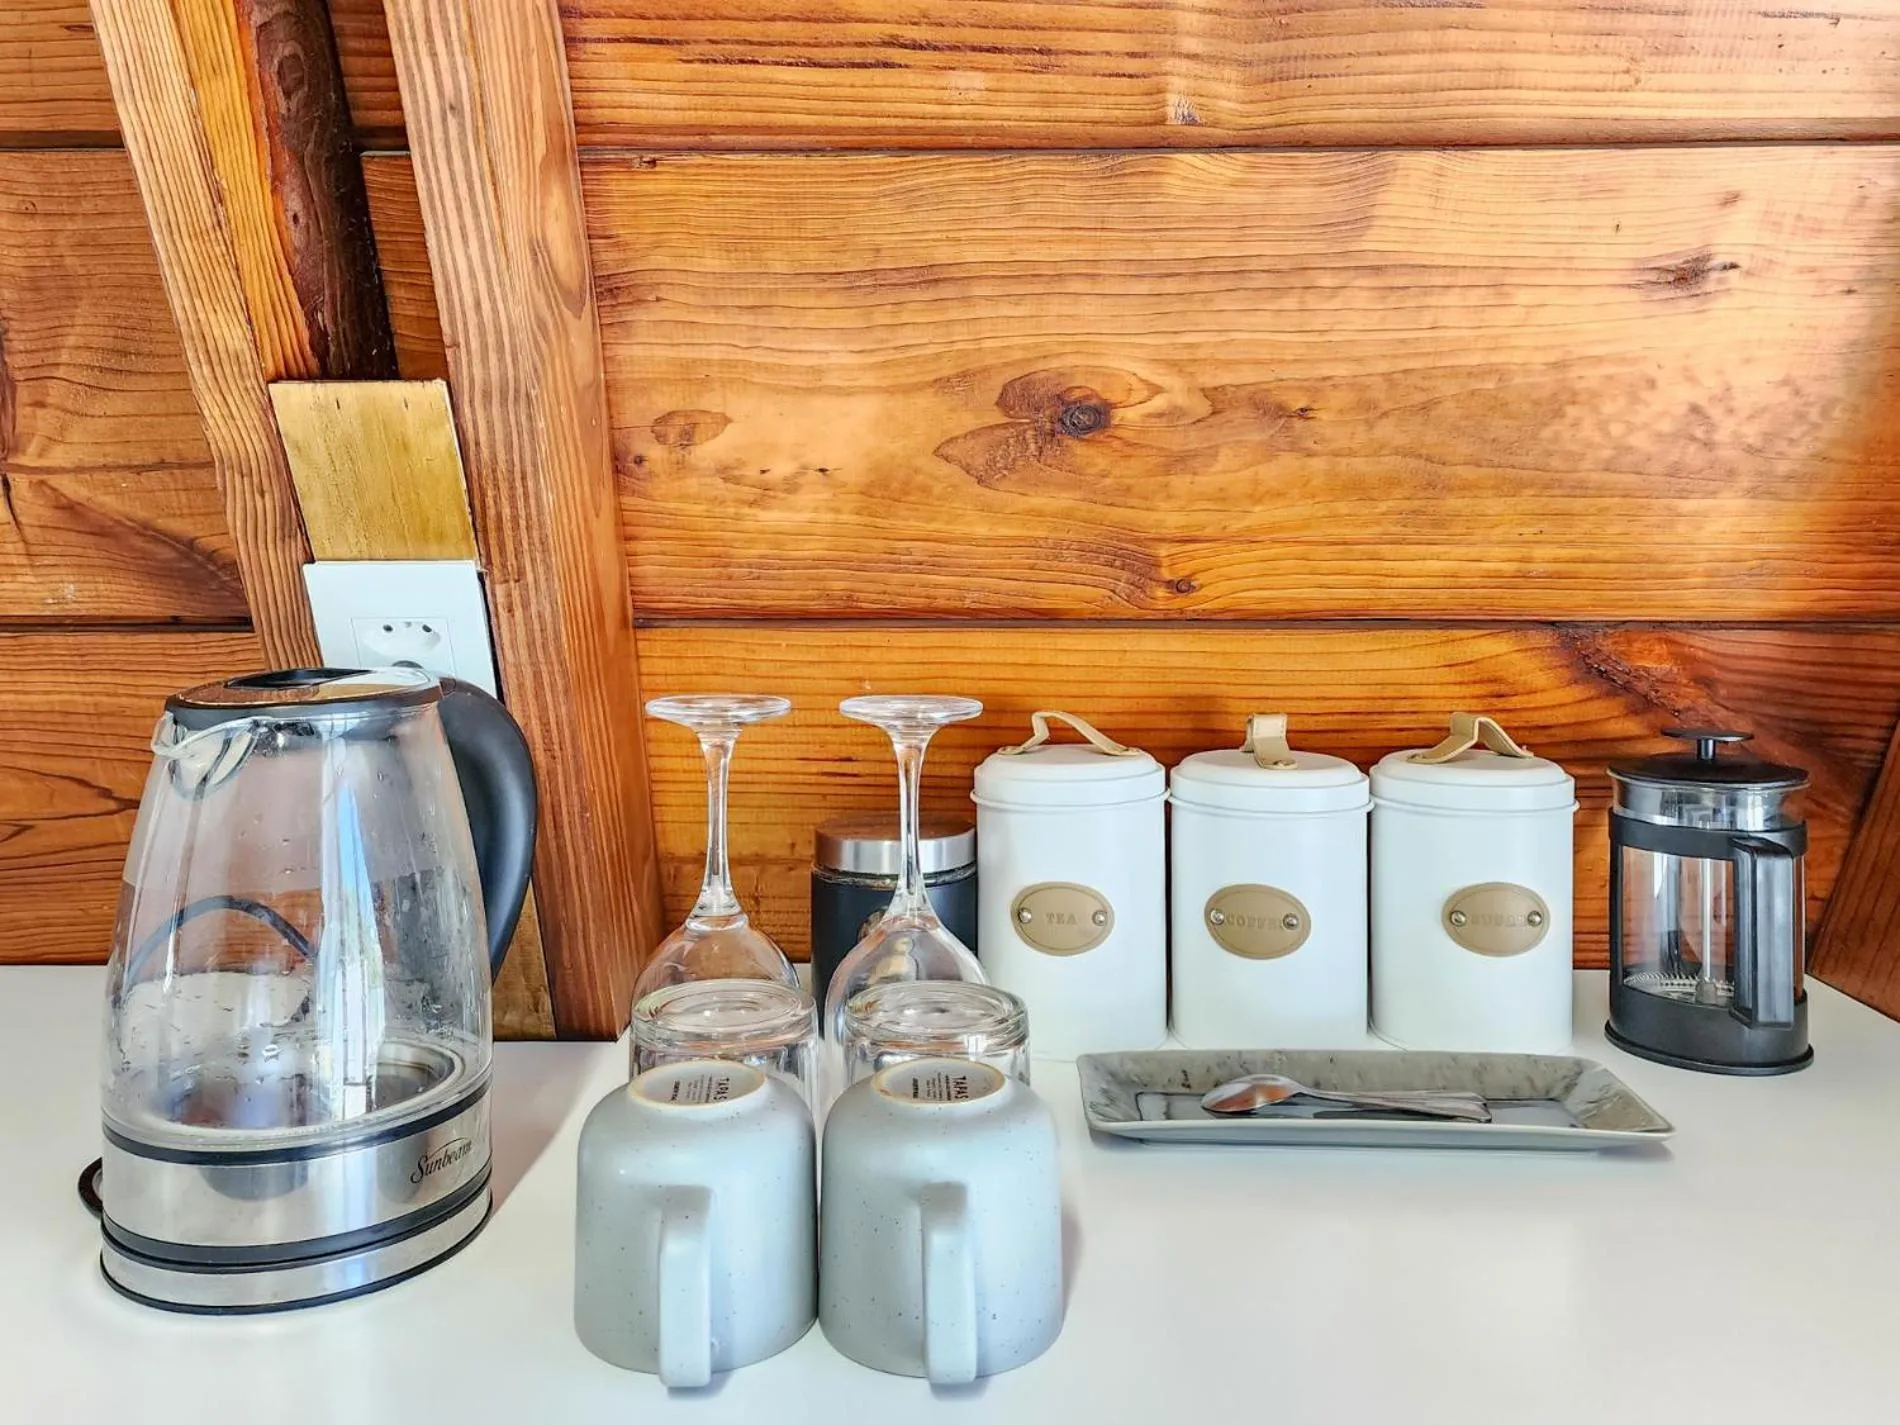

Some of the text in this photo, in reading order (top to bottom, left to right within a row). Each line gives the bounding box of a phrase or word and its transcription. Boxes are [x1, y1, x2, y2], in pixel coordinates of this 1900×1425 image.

[1045, 912, 1078, 926] TEA
[712, 1077, 730, 1100] TAPAS
[952, 1076, 969, 1099] TAPAS
[410, 1139, 472, 1184] Sunbeam
